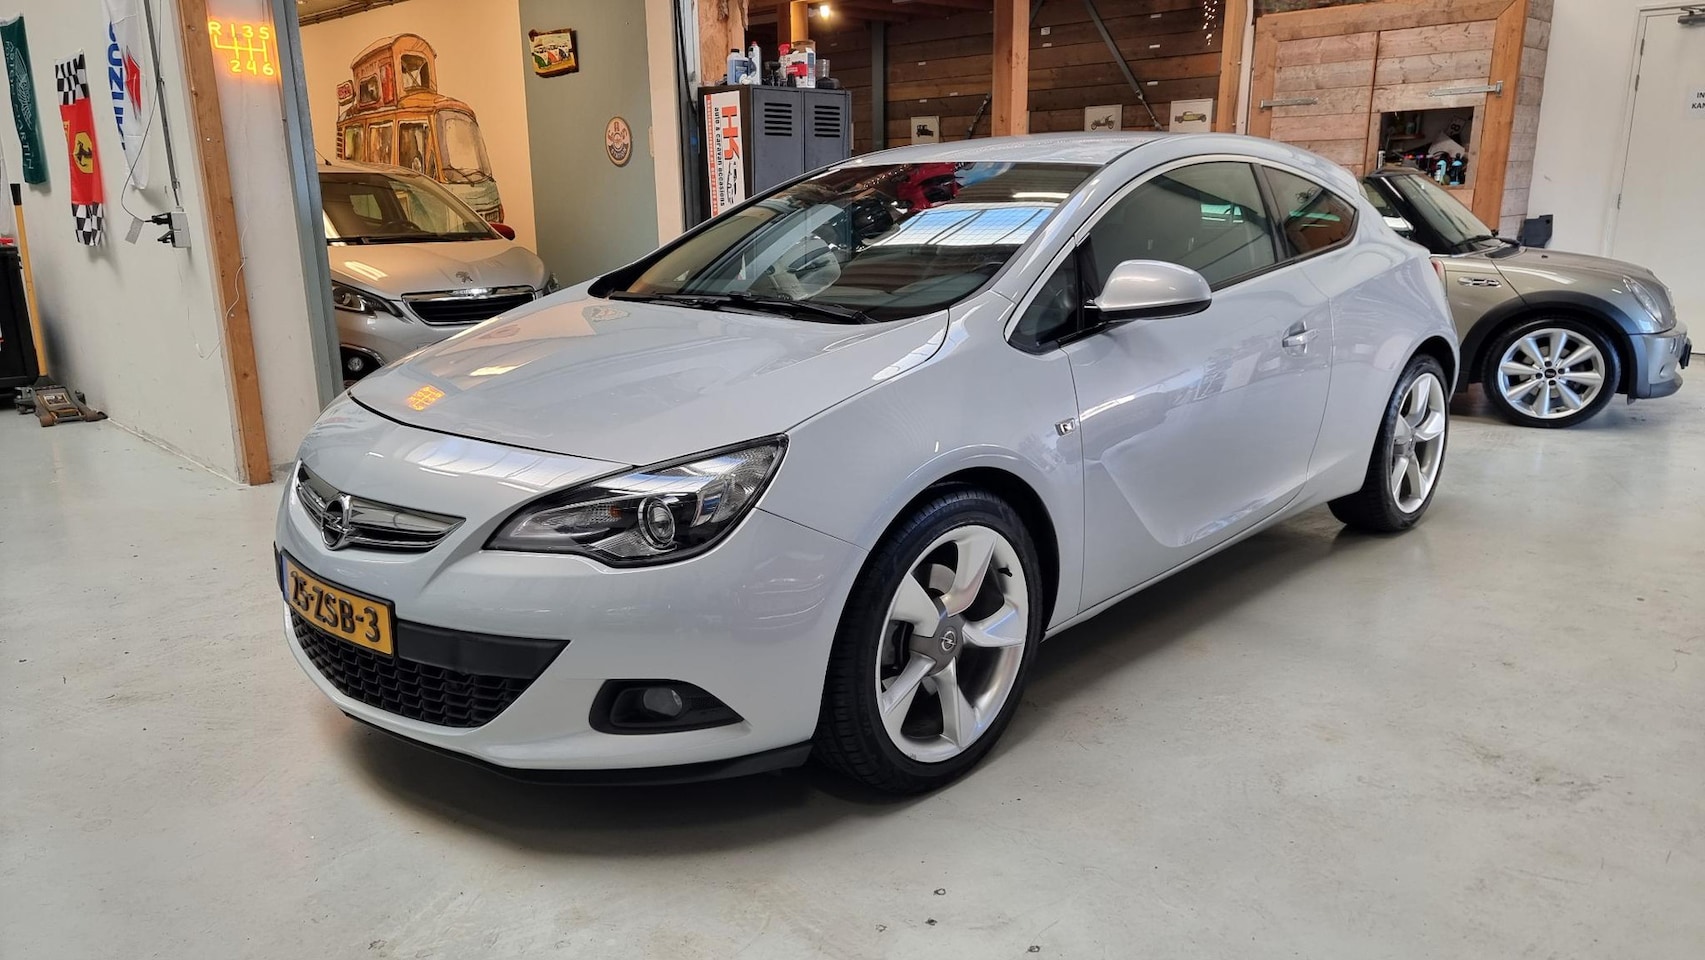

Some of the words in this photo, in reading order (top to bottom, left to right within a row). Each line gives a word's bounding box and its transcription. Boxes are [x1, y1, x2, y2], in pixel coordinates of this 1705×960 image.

[207, 20, 222, 36] R
[241, 25, 254, 38] 3
[230, 59, 242, 73] 2
[246, 60, 257, 76] 4
[262, 62, 275, 76] 6
[715, 133, 723, 166] caravan
[721, 105, 740, 161] HK
[718, 167, 726, 207] occasions
[290, 570, 381, 643] 25-ZSB-3
